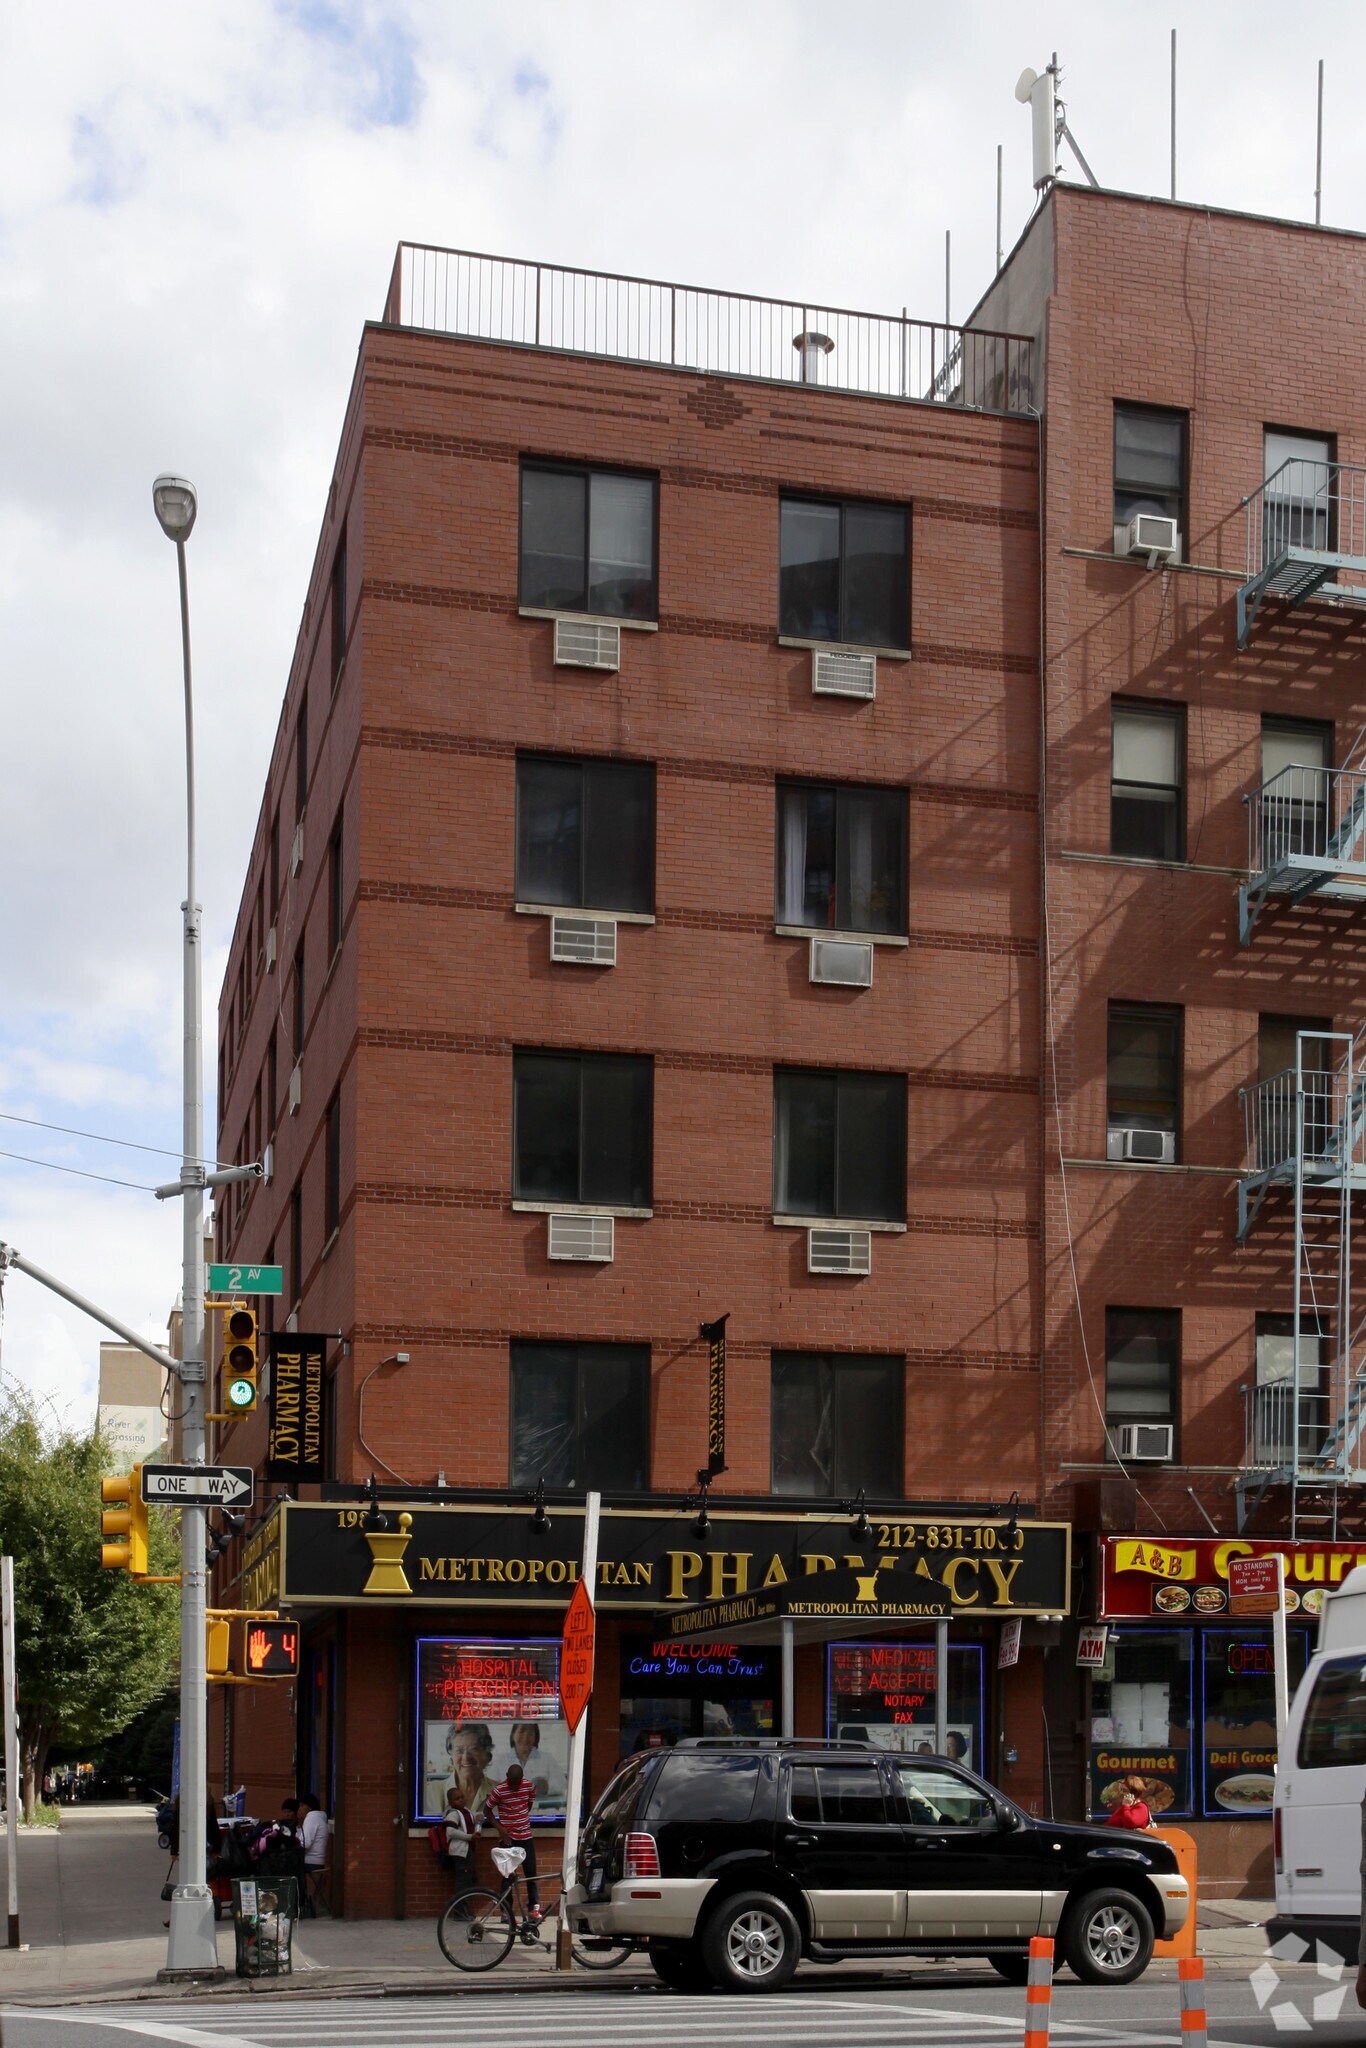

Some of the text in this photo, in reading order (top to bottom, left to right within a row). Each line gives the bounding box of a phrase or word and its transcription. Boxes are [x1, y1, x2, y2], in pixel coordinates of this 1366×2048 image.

[228, 1268, 261, 1290] 2 AV
[275, 1351, 301, 1465] PHARMACY
[305, 1353, 321, 1464] METROPOLITAN
[709, 1343, 719, 1456] PHARMACY
[107, 1418, 130, 1429] River
[107, 1431, 146, 1444] Crossing
[157, 1477, 239, 1494] ONE WAY
[419, 1557, 654, 1585] METROPOLTAN
[1244, 1561, 1274, 1571] STANDING
[671, 1608, 718, 1634] METROPOLITAN
[719, 1597, 757, 1624] PHARMACY
[788, 1602, 879, 1615] METROPOLITAN
[882, 1603, 946, 1615] PHARMACY
[570, 1610, 585, 1630] LEFT
[283, 1634, 295, 1663] 4
[563, 1635, 593, 1651] TWO LANES
[652, 1642, 739, 1658] WELCOME
[1079, 1640, 1104, 1658] ATM
[460, 1658, 538, 1677] HOSPITAL
[566, 1659, 587, 1675] CLOSED
[630, 1657, 764, 1675] Care You Can Trust
[1230, 1648, 1275, 1671] OPEN
[442, 1680, 556, 1698] PRESCRIPTION
[565, 1684, 576, 1699] 200
[459, 1700, 541, 1719] ACCEPTED
[884, 1694, 925, 1707] NOTARY
[894, 1712, 913, 1724] FAX
[1096, 1752, 1176, 1769] Gourmet
[1210, 1751, 1278, 1765] Deli Groce
